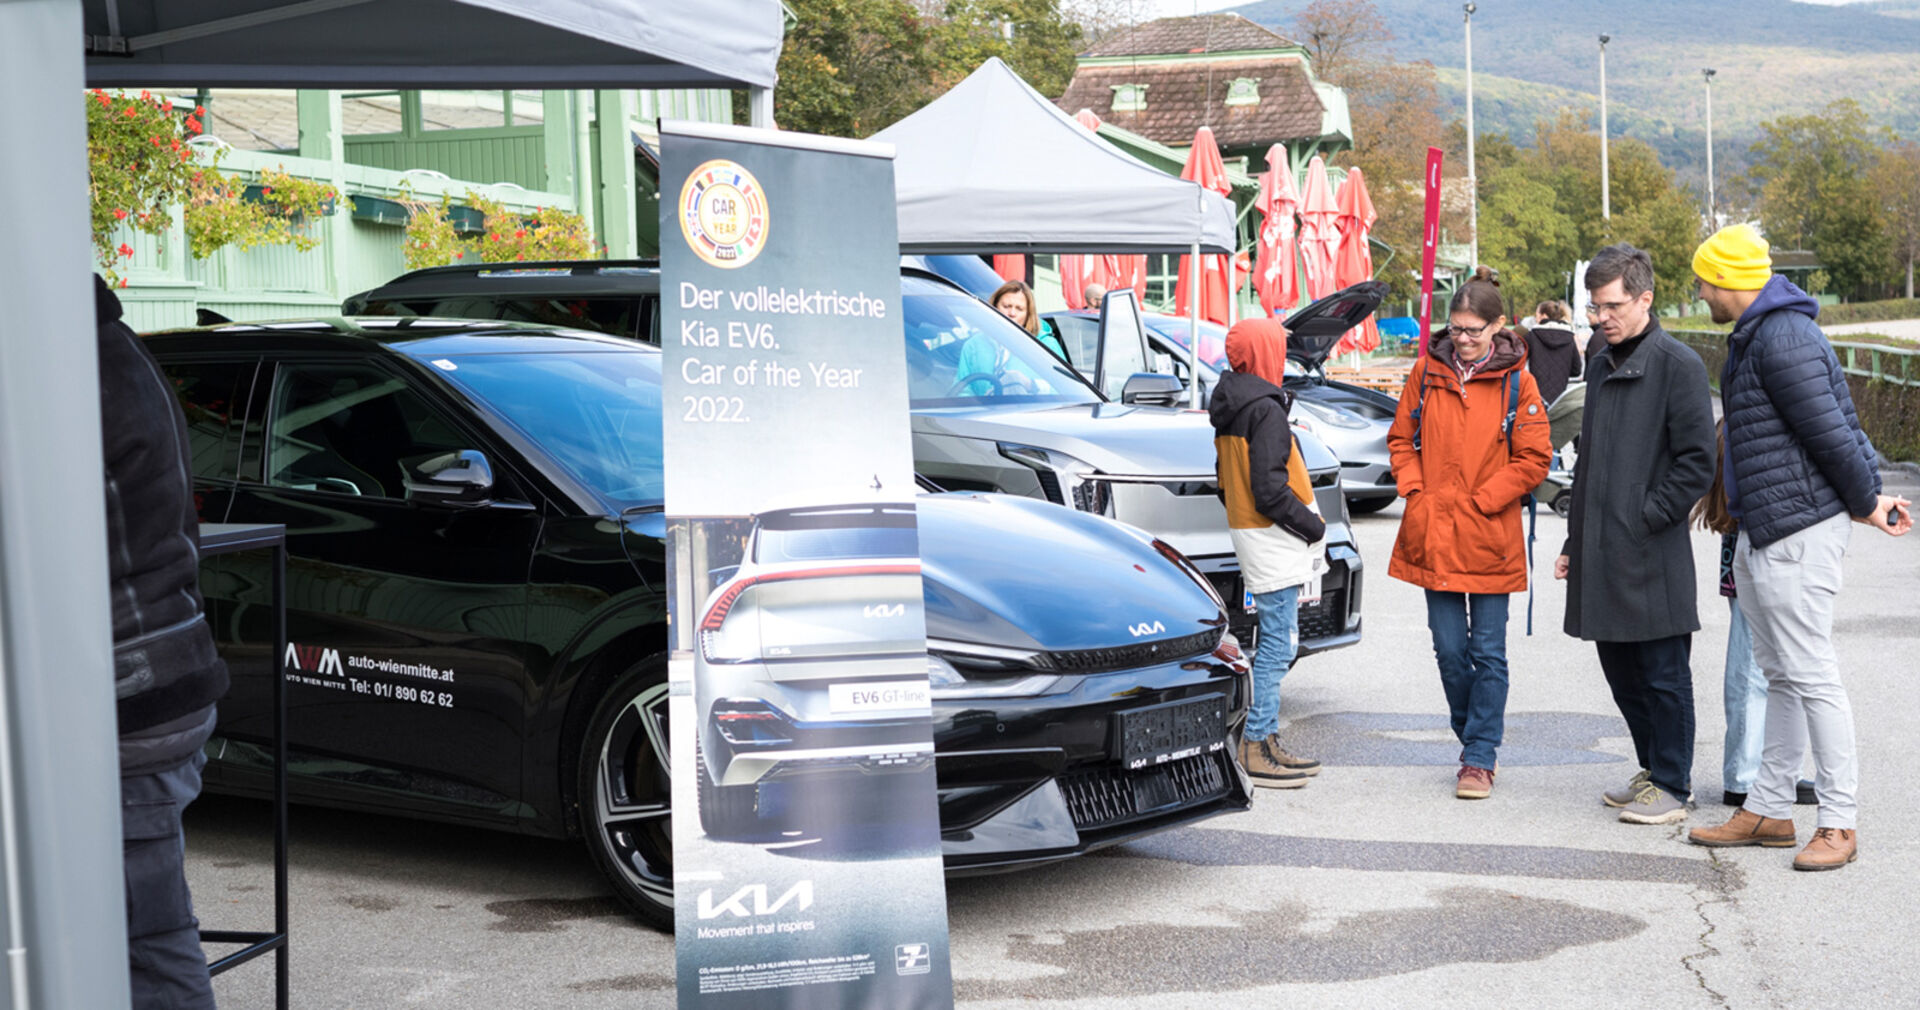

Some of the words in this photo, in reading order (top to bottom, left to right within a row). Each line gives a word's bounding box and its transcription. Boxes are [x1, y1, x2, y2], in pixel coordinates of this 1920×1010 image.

[712, 198, 737, 216] CAR
[713, 222, 738, 235] YEAR
[680, 282, 723, 310] Der
[730, 286, 886, 319] vollelektrische
[681, 321, 720, 348] Kia
[728, 322, 781, 350] EV6.
[681, 358, 726, 386] Car
[733, 360, 758, 387] of
[764, 362, 801, 388] the
[808, 363, 863, 388] Year
[683, 396, 750, 423] 2022.
[1128, 621, 1166, 636] KIA
[285, 642, 345, 677] AWM
[348, 655, 455, 682] auto-wienmitte.at
[302, 676, 322, 687] WIEN
[323, 680, 346, 690] MITTE
[349, 678, 371, 694] Tel:
[374, 682, 393, 698] 01/
[395, 686, 417, 701] 890
[420, 690, 435, 705] 62
[438, 693, 454, 708] 62
[852, 691, 880, 704] EV6
[882, 689, 925, 703] GT-line
[697, 880, 814, 920] KIA
[697, 925, 754, 939] Movement
[756, 922, 776, 934] that
[777, 919, 815, 934] inspires
